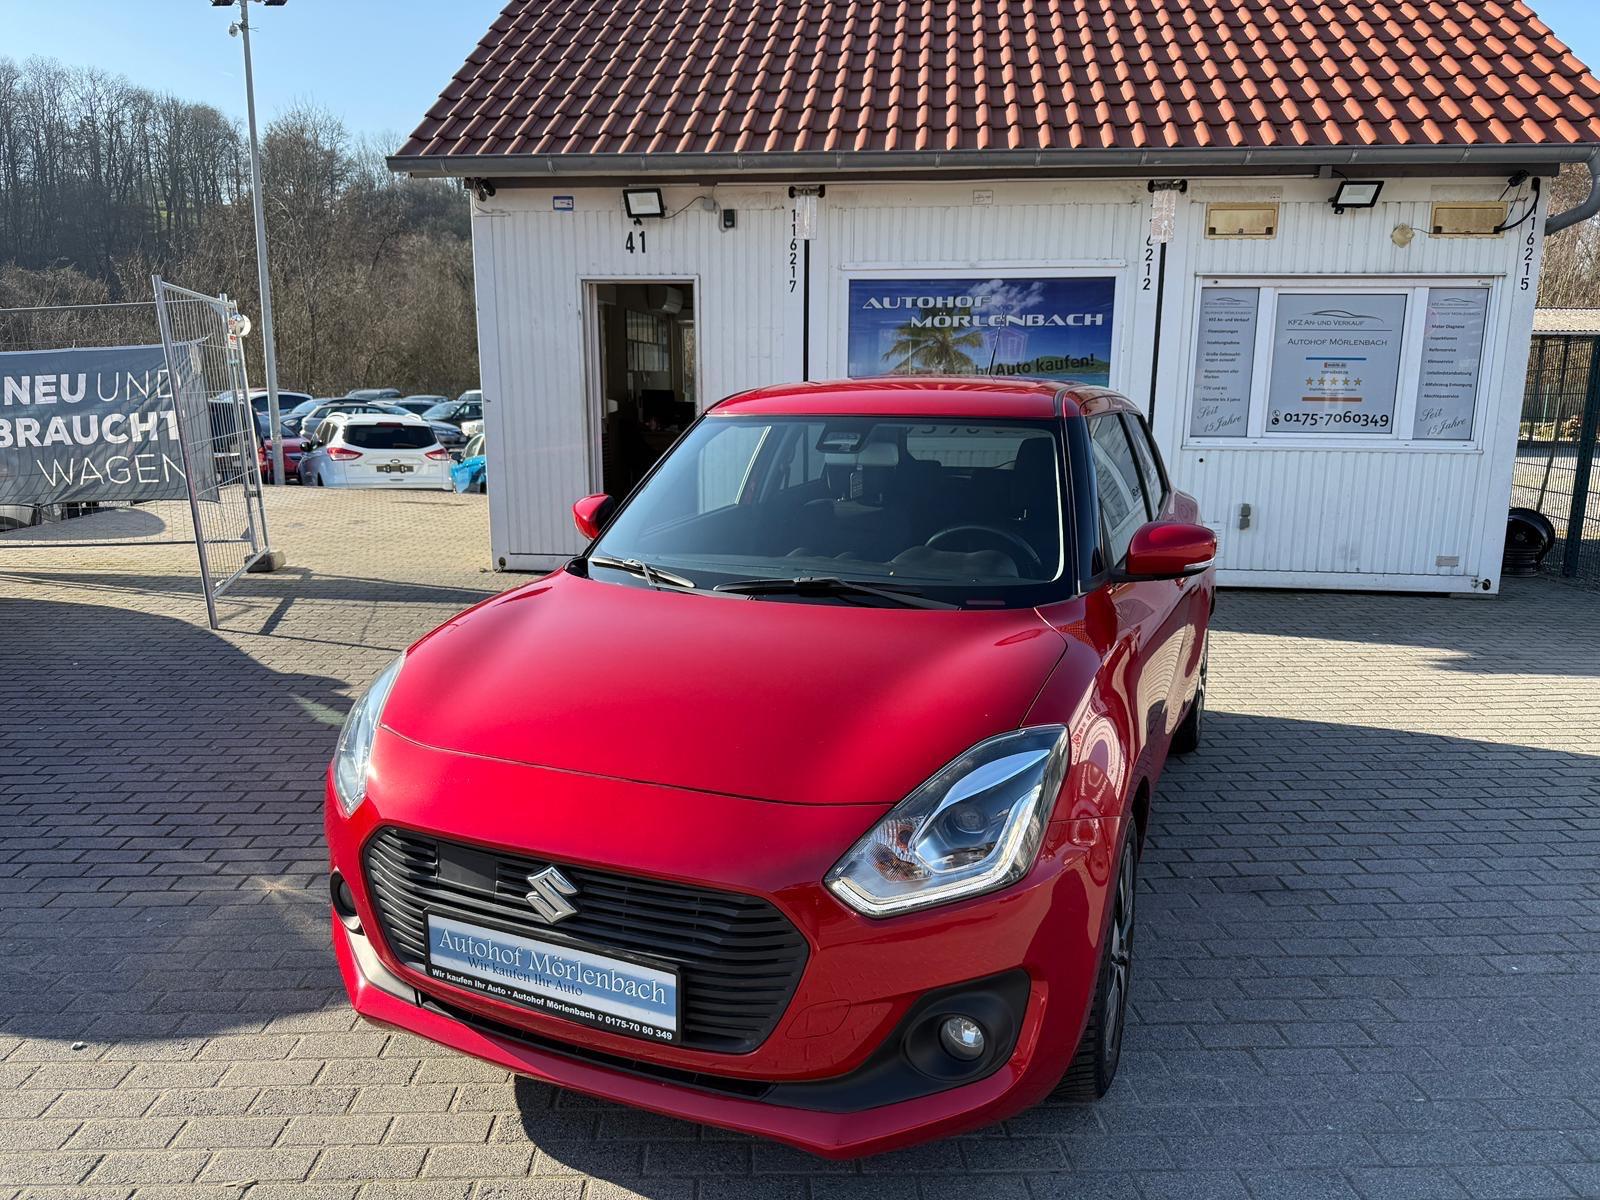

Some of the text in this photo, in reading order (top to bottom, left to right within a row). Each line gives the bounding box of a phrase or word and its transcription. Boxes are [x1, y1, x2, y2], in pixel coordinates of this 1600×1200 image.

[625, 231, 646, 254] 41
[789, 208, 798, 293] 116217
[862, 295, 992, 310] AUTOHOF
[910, 311, 1104, 328] MÖRLENBACH
[995, 362, 1032, 377] Auto
[1035, 353, 1096, 373] kaufen!
[3, 373, 87, 406] NEU
[1283, 410, 1390, 427] 0175-7060349
[439, 927, 667, 1005] Autohof Mörlenbach
[468, 956, 583, 997] Wir kaufen Ihr Auto
[431, 968, 673, 1041] Wir kaufen Ihr Auto Autohof Mörlenbach 0175-70 60 349
